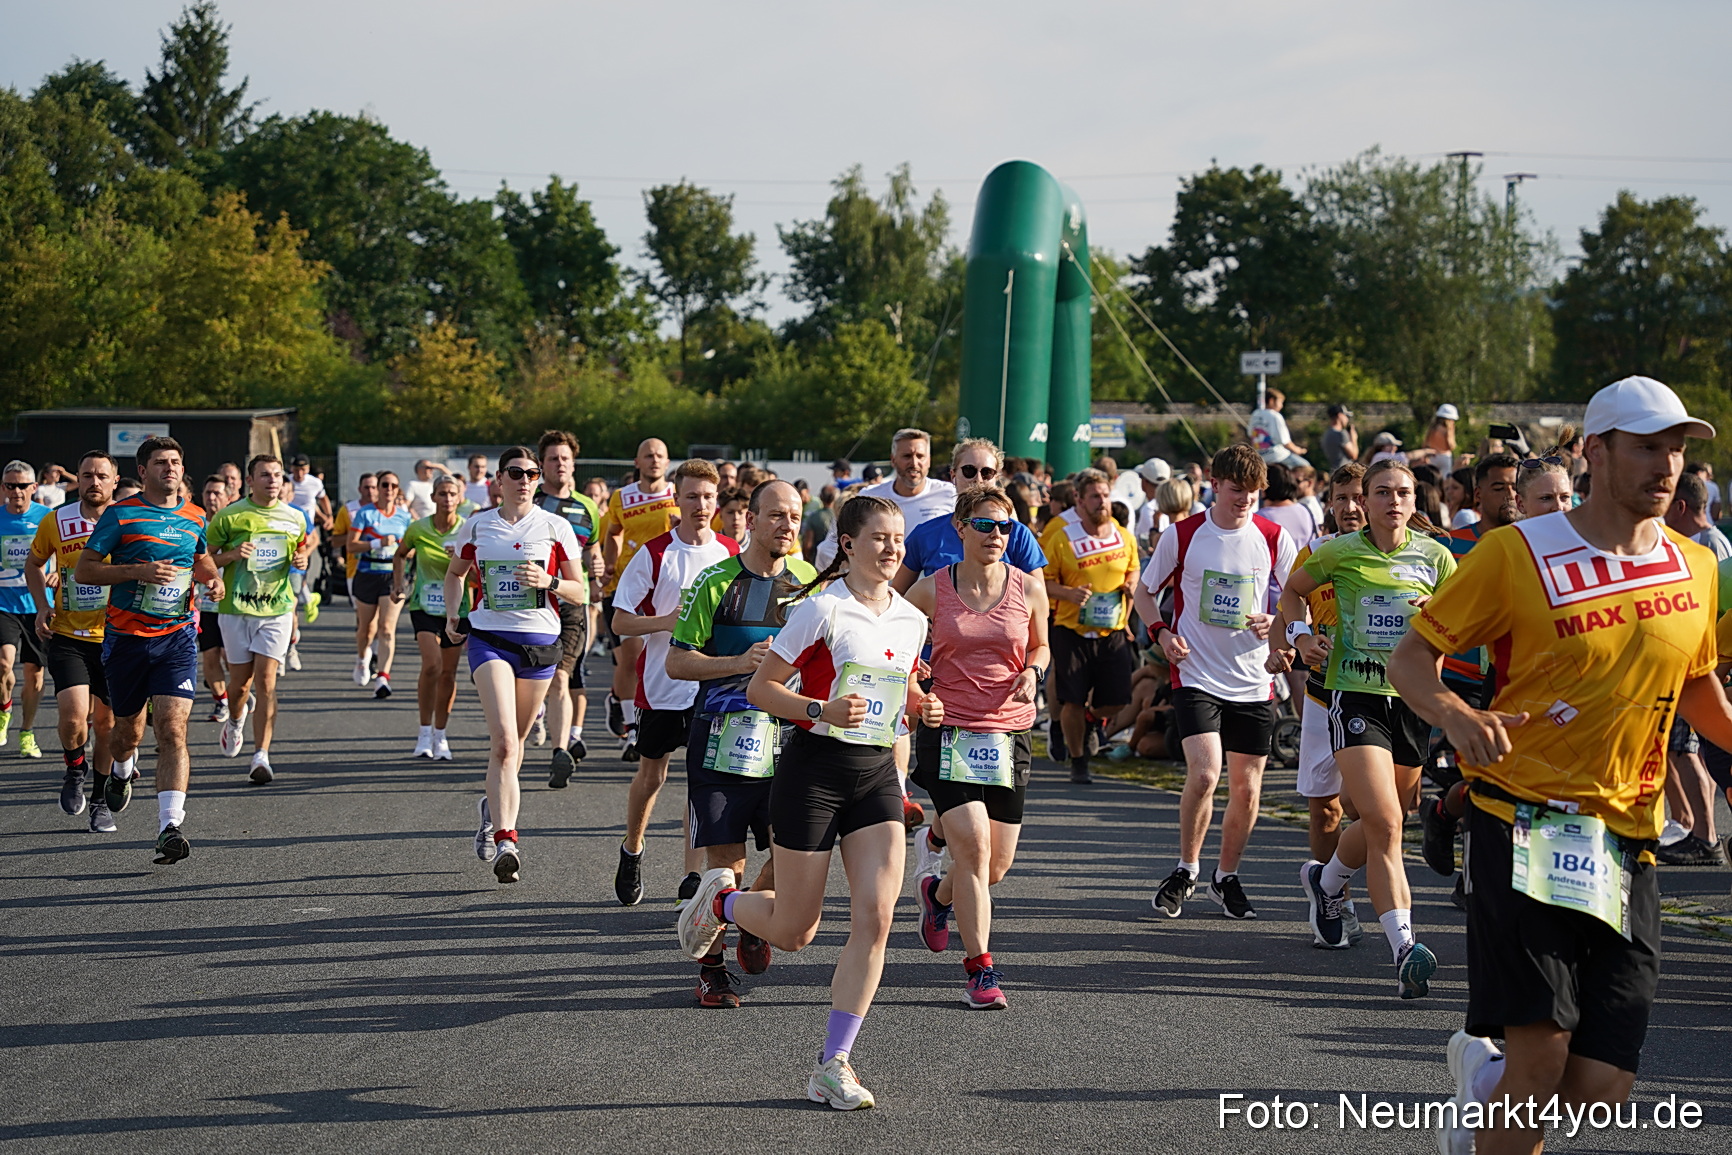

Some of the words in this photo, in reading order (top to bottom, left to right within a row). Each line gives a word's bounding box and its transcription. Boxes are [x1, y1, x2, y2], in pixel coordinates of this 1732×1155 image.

[1029, 423, 1048, 443] AO
[1072, 423, 1091, 442] AO
[623, 507, 646, 520] MAX
[256, 549, 278, 557] 1359
[1078, 557, 1102, 569] MAX
[75, 586, 102, 595] 1663
[158, 586, 180, 598] 473
[499, 581, 520, 591] 216
[427, 594, 445, 603] 133
[1214, 594, 1240, 608] 642
[1368, 614, 1404, 627] 1369
[1554, 605, 1627, 639] MAX
[1634, 590, 1699, 621] BÖGL
[865, 698, 883, 715] 00
[865, 717, 884, 727] Börner
[735, 736, 761, 752] 432
[728, 751, 753, 760] Benjamin
[968, 748, 999, 761] 433
[1547, 873, 1587, 888] Andreas
